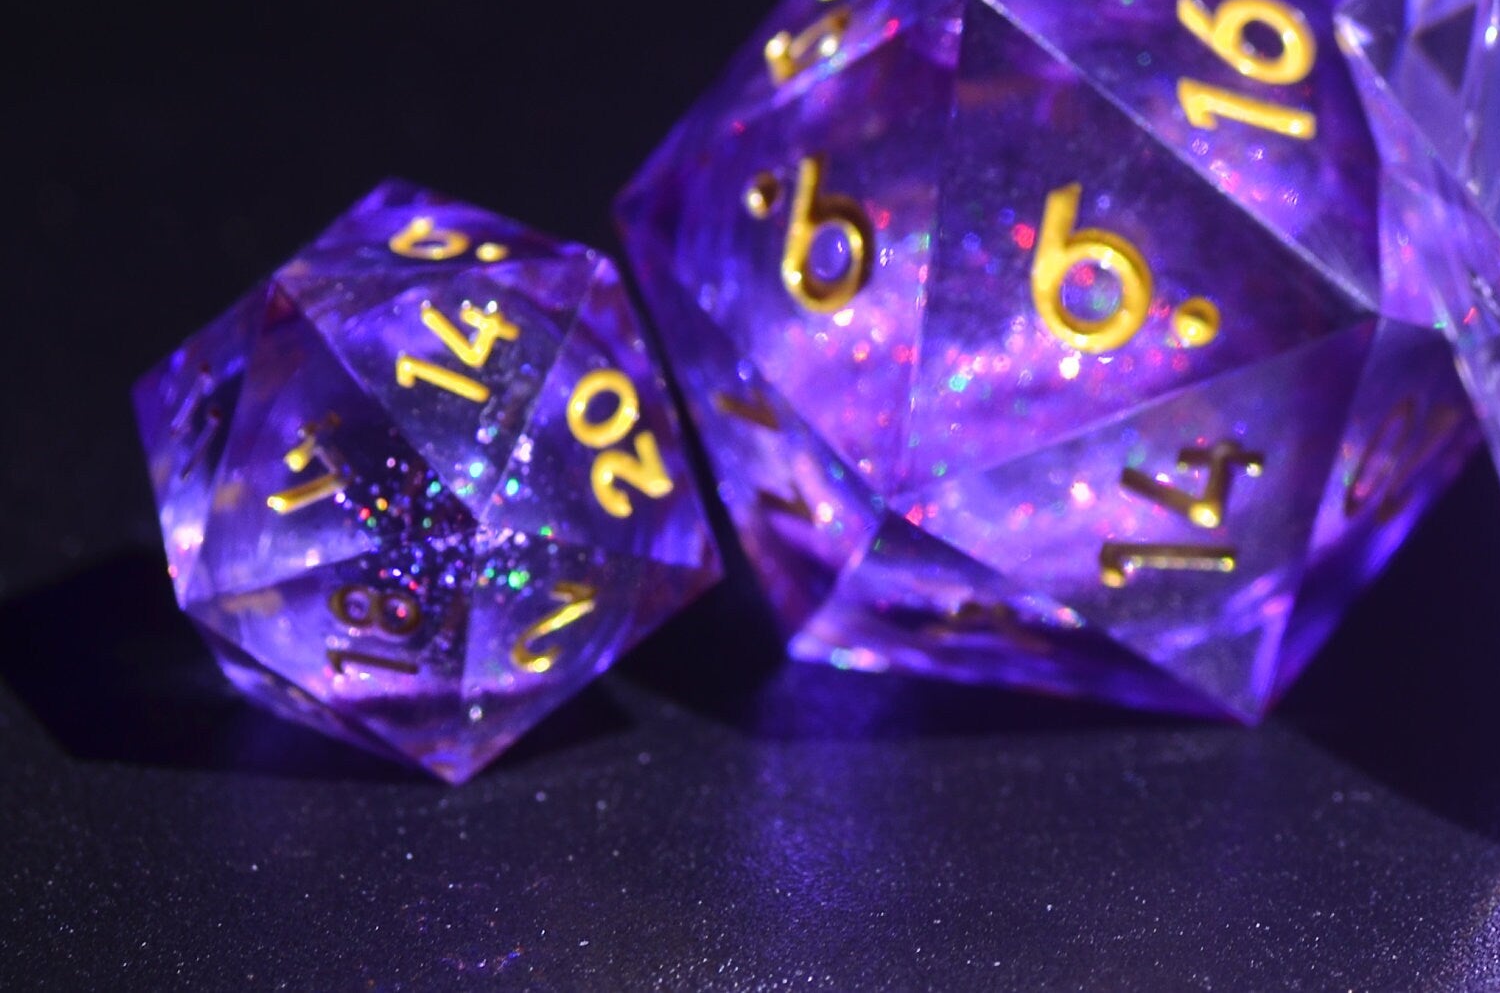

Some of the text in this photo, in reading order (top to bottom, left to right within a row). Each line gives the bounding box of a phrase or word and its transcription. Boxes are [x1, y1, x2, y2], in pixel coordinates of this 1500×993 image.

[395, 301, 520, 404] 14
[565, 368, 674, 520] 20
[1098, 438, 1266, 588] 14
[326, 582, 424, 676] 18
